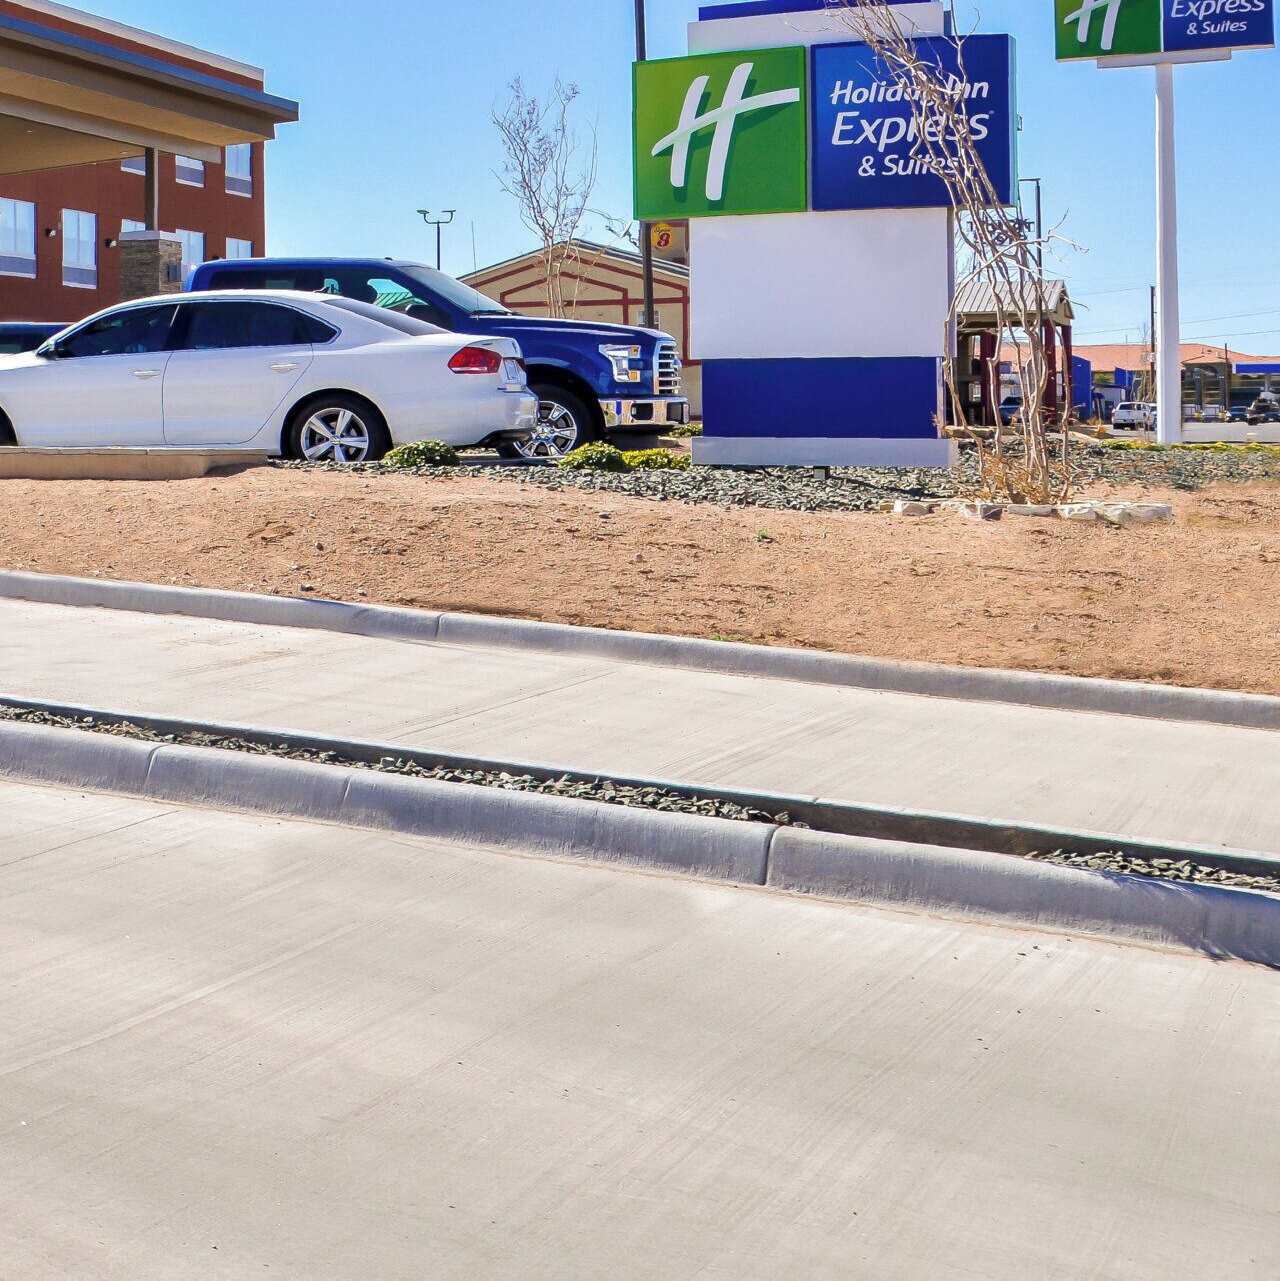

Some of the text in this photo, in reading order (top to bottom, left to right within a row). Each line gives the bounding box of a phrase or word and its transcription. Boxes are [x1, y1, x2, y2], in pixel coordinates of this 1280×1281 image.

[1186, 21, 1247, 35] & Suites
[858, 154, 959, 176] & Suites
